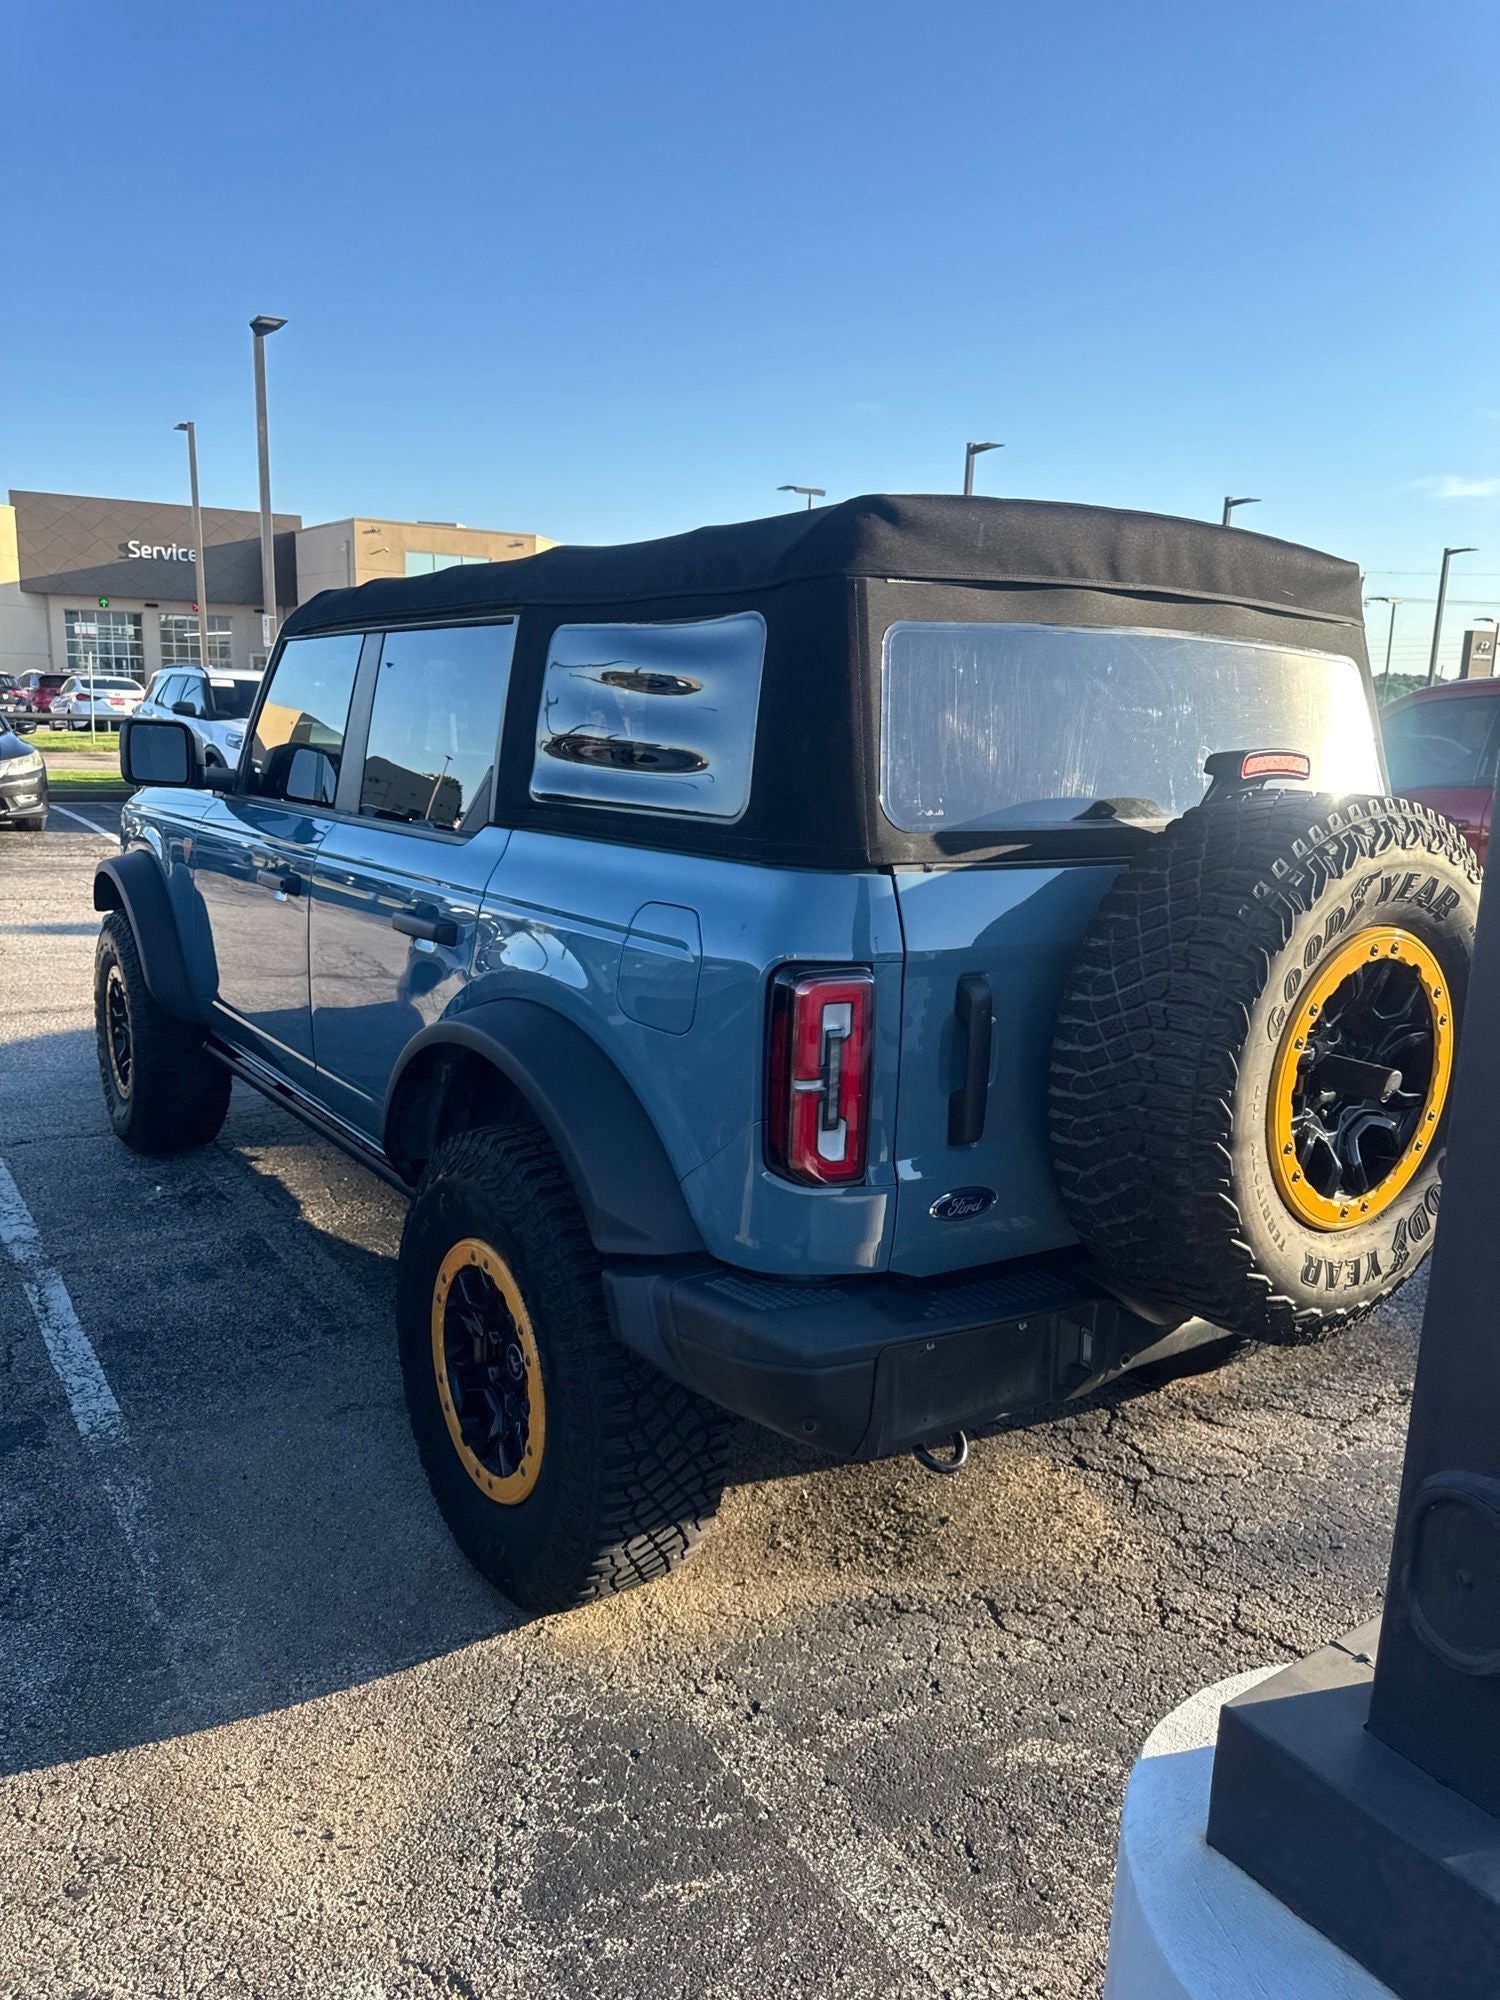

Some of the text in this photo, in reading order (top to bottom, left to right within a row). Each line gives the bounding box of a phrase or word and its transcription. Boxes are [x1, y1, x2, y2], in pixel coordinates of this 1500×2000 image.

[128, 540, 196, 562] Service
[947, 1196, 983, 1217] Ford
[1250, 1142, 1288, 1253] TERRITORY
[1300, 1183, 1442, 1291] ODYEAR
